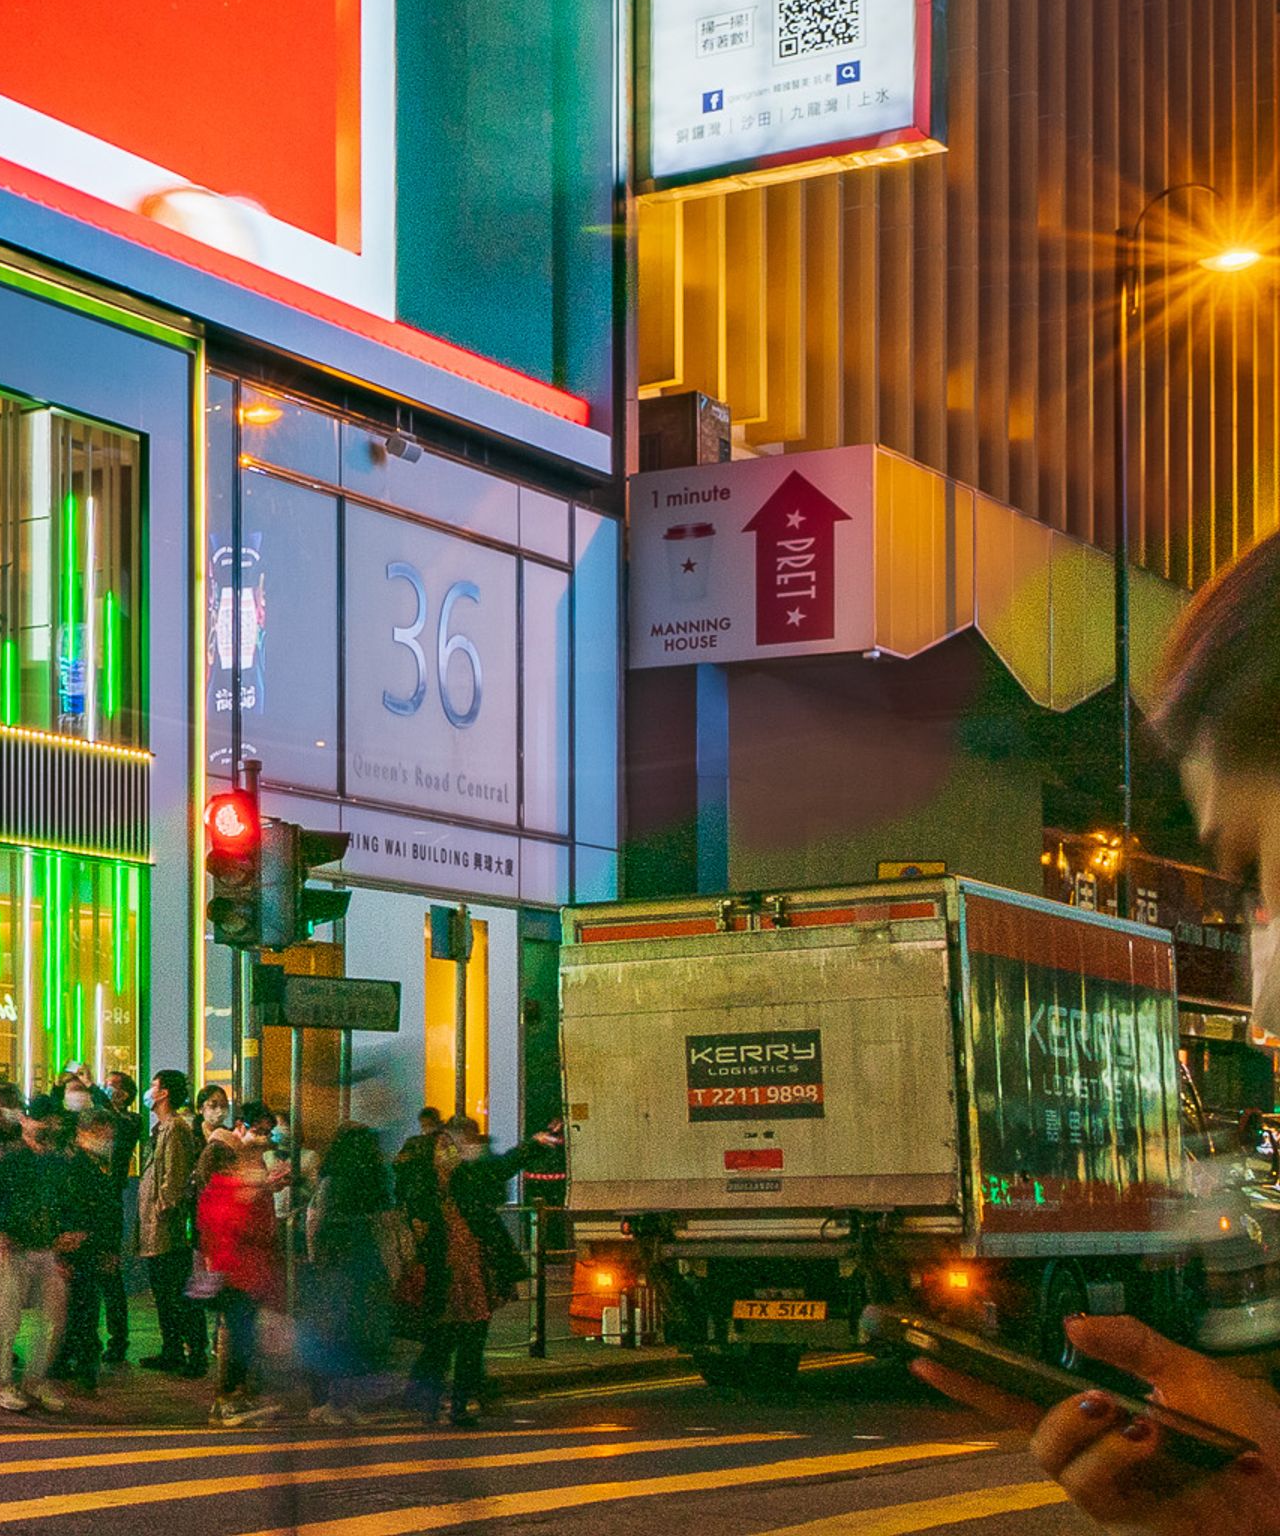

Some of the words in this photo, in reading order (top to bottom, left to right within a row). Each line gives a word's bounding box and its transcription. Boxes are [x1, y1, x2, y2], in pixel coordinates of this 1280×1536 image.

[651, 490, 659, 509] 1
[666, 484, 731, 507] minute
[776, 537, 816, 599] PRET
[651, 617, 732, 637] MANNING
[382, 562, 482, 730] 36
[664, 634, 718, 652] HOUSE
[352, 753, 408, 785] Queen's
[415, 765, 450, 792] Road
[456, 772, 509, 804] Central
[385, 838, 407, 857] WAI
[412, 843, 469, 868] BUILDING
[691, 1042, 815, 1065] KERRY
[708, 1064, 799, 1076] LOGISTICS
[693, 1088, 707, 1104] T
[711, 1087, 760, 1105] 2211
[746, 1303, 768, 1317] TX
[778, 1303, 815, 1317] 5141
